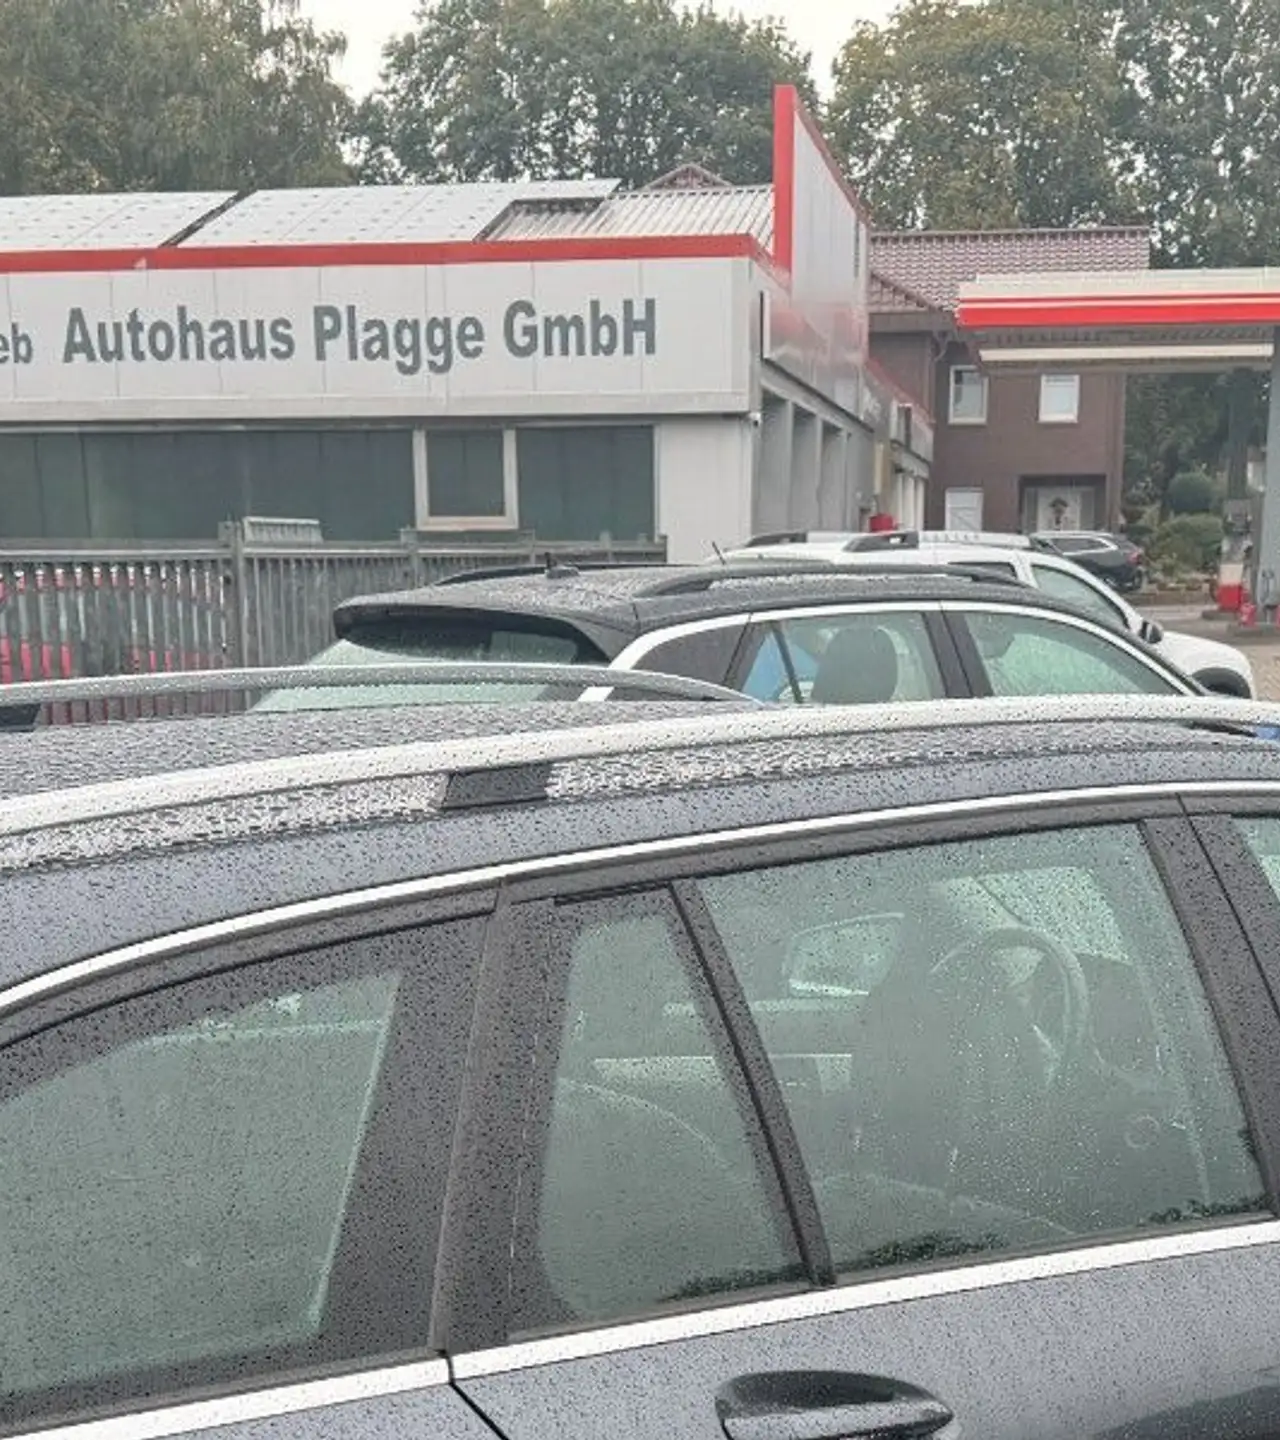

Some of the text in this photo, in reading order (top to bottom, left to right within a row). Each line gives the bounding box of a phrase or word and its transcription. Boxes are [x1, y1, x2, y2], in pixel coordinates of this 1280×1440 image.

[62, 304, 297, 363] Autohaus
[313, 304, 486, 376] Plagge
[503, 298, 657, 359] GmbH
